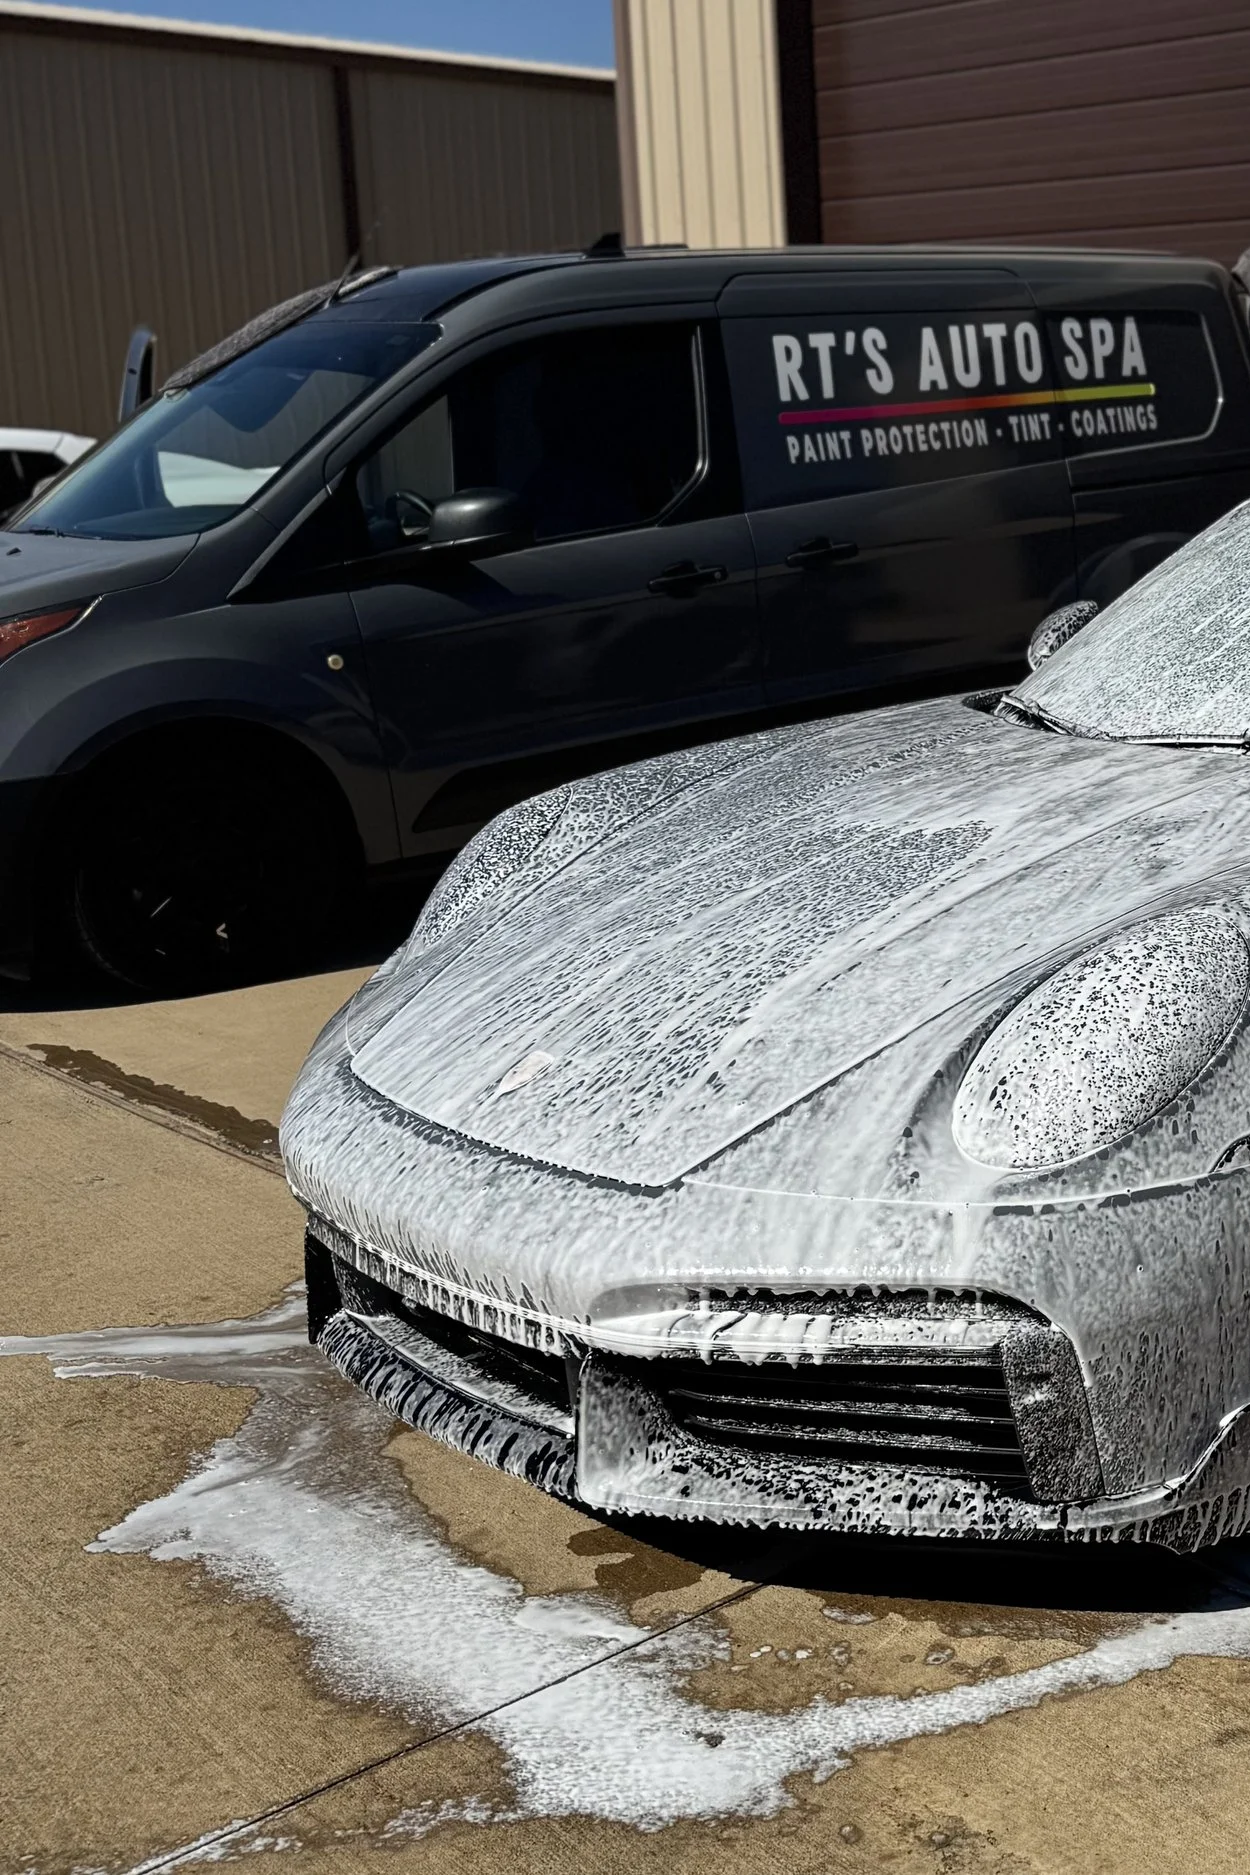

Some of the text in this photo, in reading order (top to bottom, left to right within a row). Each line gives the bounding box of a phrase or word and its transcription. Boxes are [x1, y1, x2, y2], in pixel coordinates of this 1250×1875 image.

[772, 316, 1147, 402] RT'S AUTO SPA
[786, 404, 1158, 464] PAINT PROTECTION TINT COATINGS
